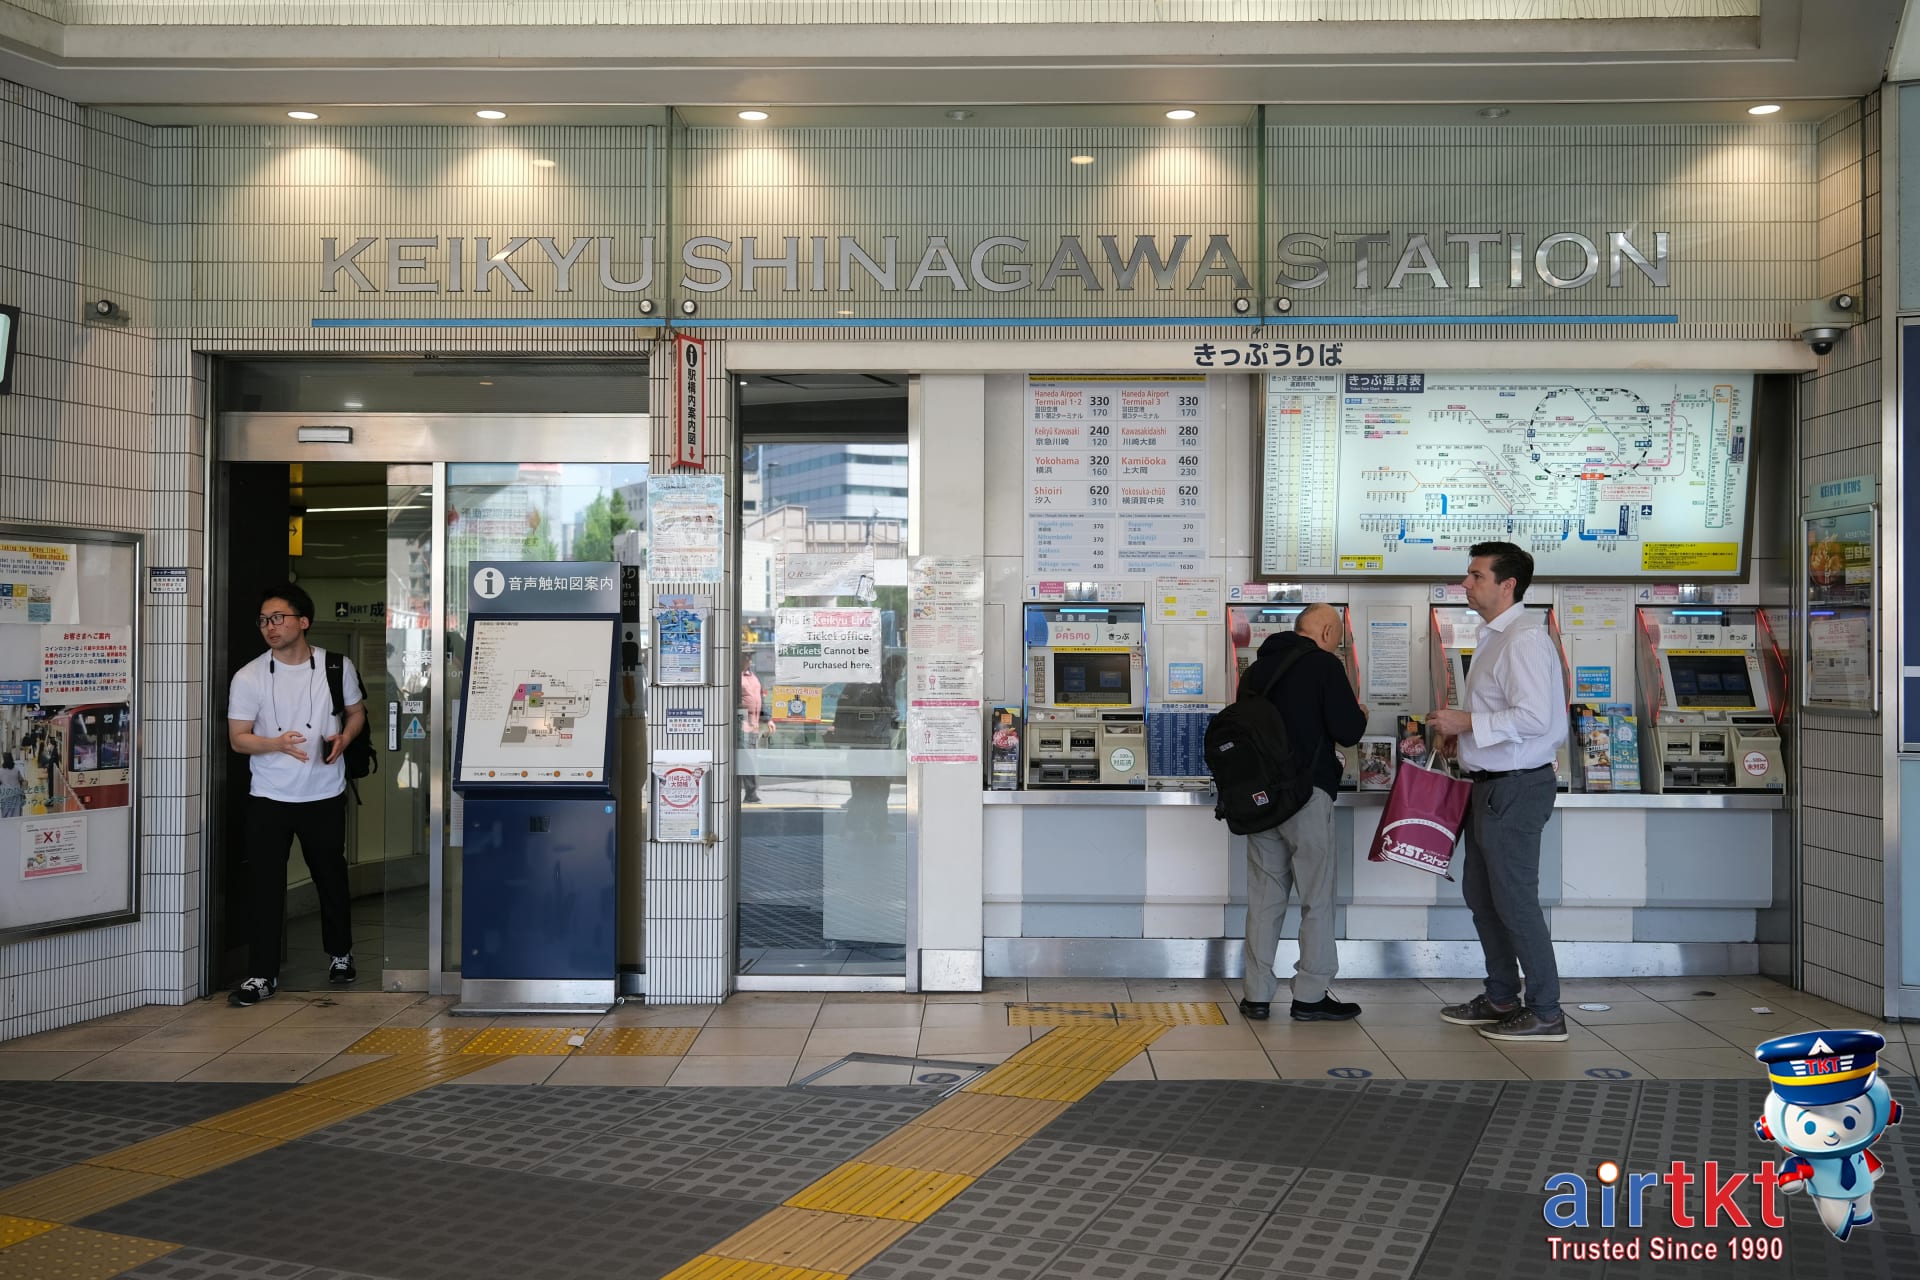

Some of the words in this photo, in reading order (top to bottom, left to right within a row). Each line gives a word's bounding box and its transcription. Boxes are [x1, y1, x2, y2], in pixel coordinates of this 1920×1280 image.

[320, 236, 655, 294] KEIKYU
[681, 234, 1253, 293] SHINAGAWA
[1276, 231, 1671, 290] STATION
[1194, 342, 1344, 368] きっぷうりば
[1348, 374, 1422, 386] きっぷ運賃表
[1034, 390, 1058, 398] Haneda
[1060, 390, 1083, 399] Airport
[1121, 390, 1146, 398] Haneda
[1147, 390, 1170, 399] Airport
[1090, 396, 1110, 406] 330
[1178, 396, 1198, 406] 330
[687, 368, 697, 446] 駅構内案内図
[1054, 427, 1080, 436] Kawasaki
[1090, 426, 1110, 436] 240
[1121, 427, 1167, 436] Kawasakidaishi
[1178, 426, 1198, 436] 280
[1036, 438, 1070, 446] 京急川崎
[1122, 438, 1157, 446] 川崎大師
[1035, 456, 1080, 465] Yokohama
[1090, 456, 1110, 466] 320
[1178, 456, 1198, 466] 460
[1092, 468, 1108, 476] 160
[1122, 466, 1148, 474] 上大岡
[1180, 468, 1197, 476] 230
[1034, 486, 1062, 495] Shioiri
[1090, 486, 1110, 496] 620
[1178, 486, 1198, 496] 620
[1820, 484, 1842, 498] KEIKYU
[1844, 480, 1861, 494] NEWS
[1034, 496, 1052, 504] 汐入
[1092, 498, 1108, 506] 310
[1122, 496, 1164, 504] 横須賀中央
[1180, 498, 1197, 506] 310
[508, 576, 614, 592] 音声触知図案内
[1030, 586, 1036, 597] 1
[1230, 588, 1240, 598] 2
[1434, 588, 1444, 598] 3
[1640, 589, 1650, 600] 4
[350, 605, 368, 614] NRT
[778, 615, 800, 624] This
[814, 616, 848, 627] Keikyu
[806, 631, 838, 640] Ticket
[779, 647, 789, 655] JR
[791, 647, 821, 655] Tickets
[824, 646, 856, 655] Cannot
[858, 646, 870, 655] be
[802, 661, 848, 669] Purchased
[850, 661, 872, 669] here.
